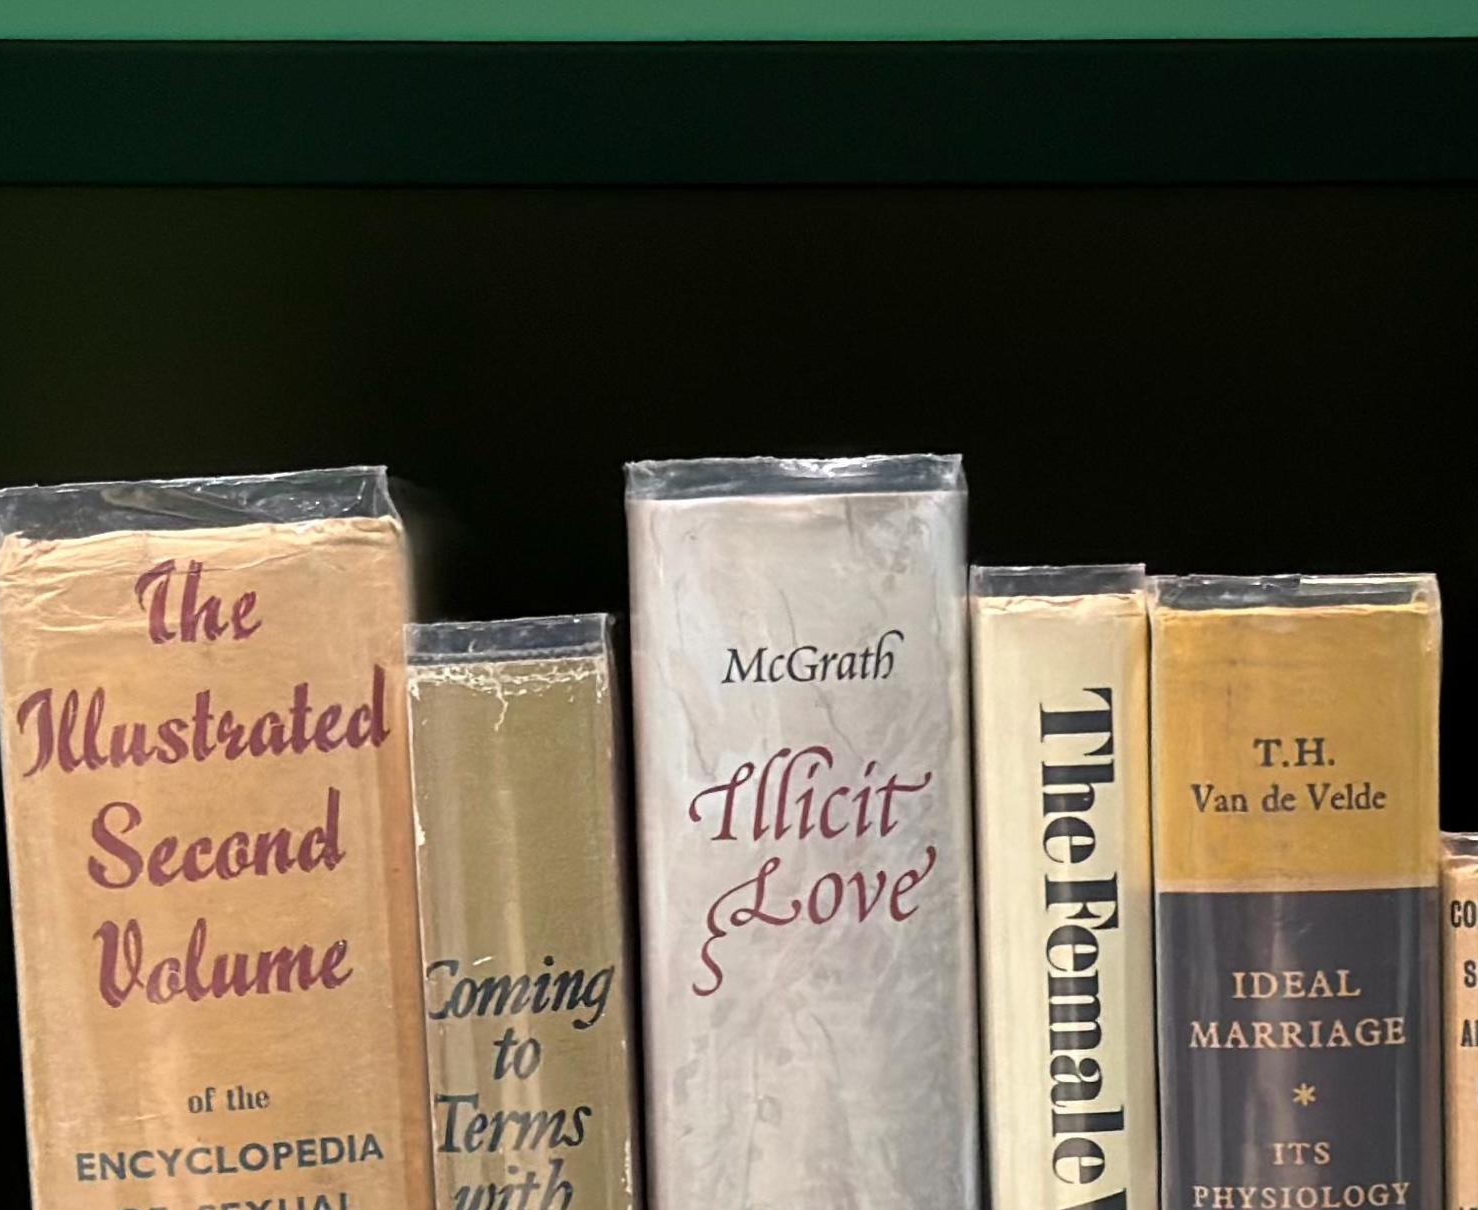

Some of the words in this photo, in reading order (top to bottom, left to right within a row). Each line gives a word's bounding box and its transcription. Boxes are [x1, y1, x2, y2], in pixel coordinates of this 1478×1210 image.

[135, 559, 261, 644] The
[722, 629, 904, 684] McGrath
[17, 664, 389, 778] Illustrated
[689, 745, 931, 841] Illicit
[1039, 687, 1115, 865] The
[1191, 784, 1248, 812] Van
[1262, 784, 1296, 812] de
[1306, 782, 1386, 810] Velde
[88, 787, 346, 889] Second
[93, 917, 352, 1008] Volume
[1232, 970, 1361, 999] IDEAL
[493, 1028, 541, 1080] to
[1045, 872, 1125, 1185] Female
[1189, 1018, 1406, 1048] MARRIAGE
[188, 1086, 216, 1114] of
[226, 1085, 269, 1111] the
[435, 1092, 592, 1152] Terms
[76, 1133, 384, 1181] ENCYCLOPEDIA
[1273, 1142, 1330, 1165] ITS
[1193, 1182, 1410, 1209] PHYSIOLOGY
